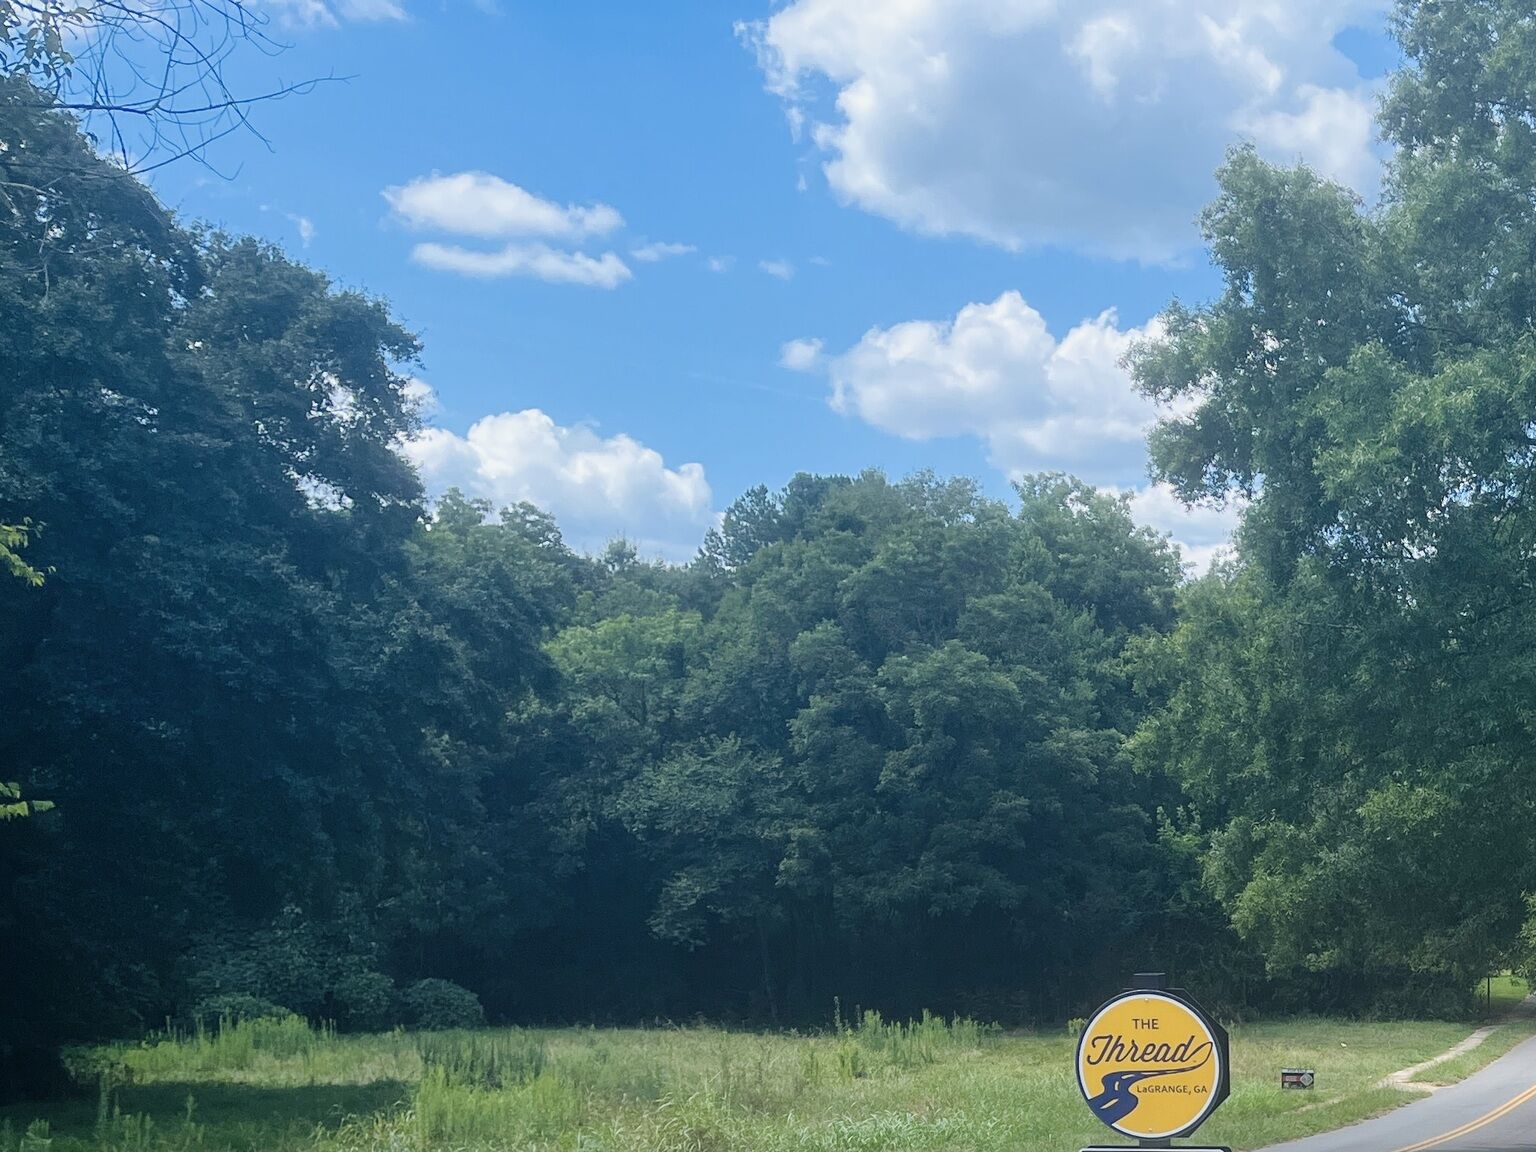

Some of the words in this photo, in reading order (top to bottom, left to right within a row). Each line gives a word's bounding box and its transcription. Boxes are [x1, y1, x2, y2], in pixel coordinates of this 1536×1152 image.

[1132, 1018, 1159, 1030] THE
[1086, 1034, 1203, 1065] Thread
[1193, 1085, 1208, 1094] GA
